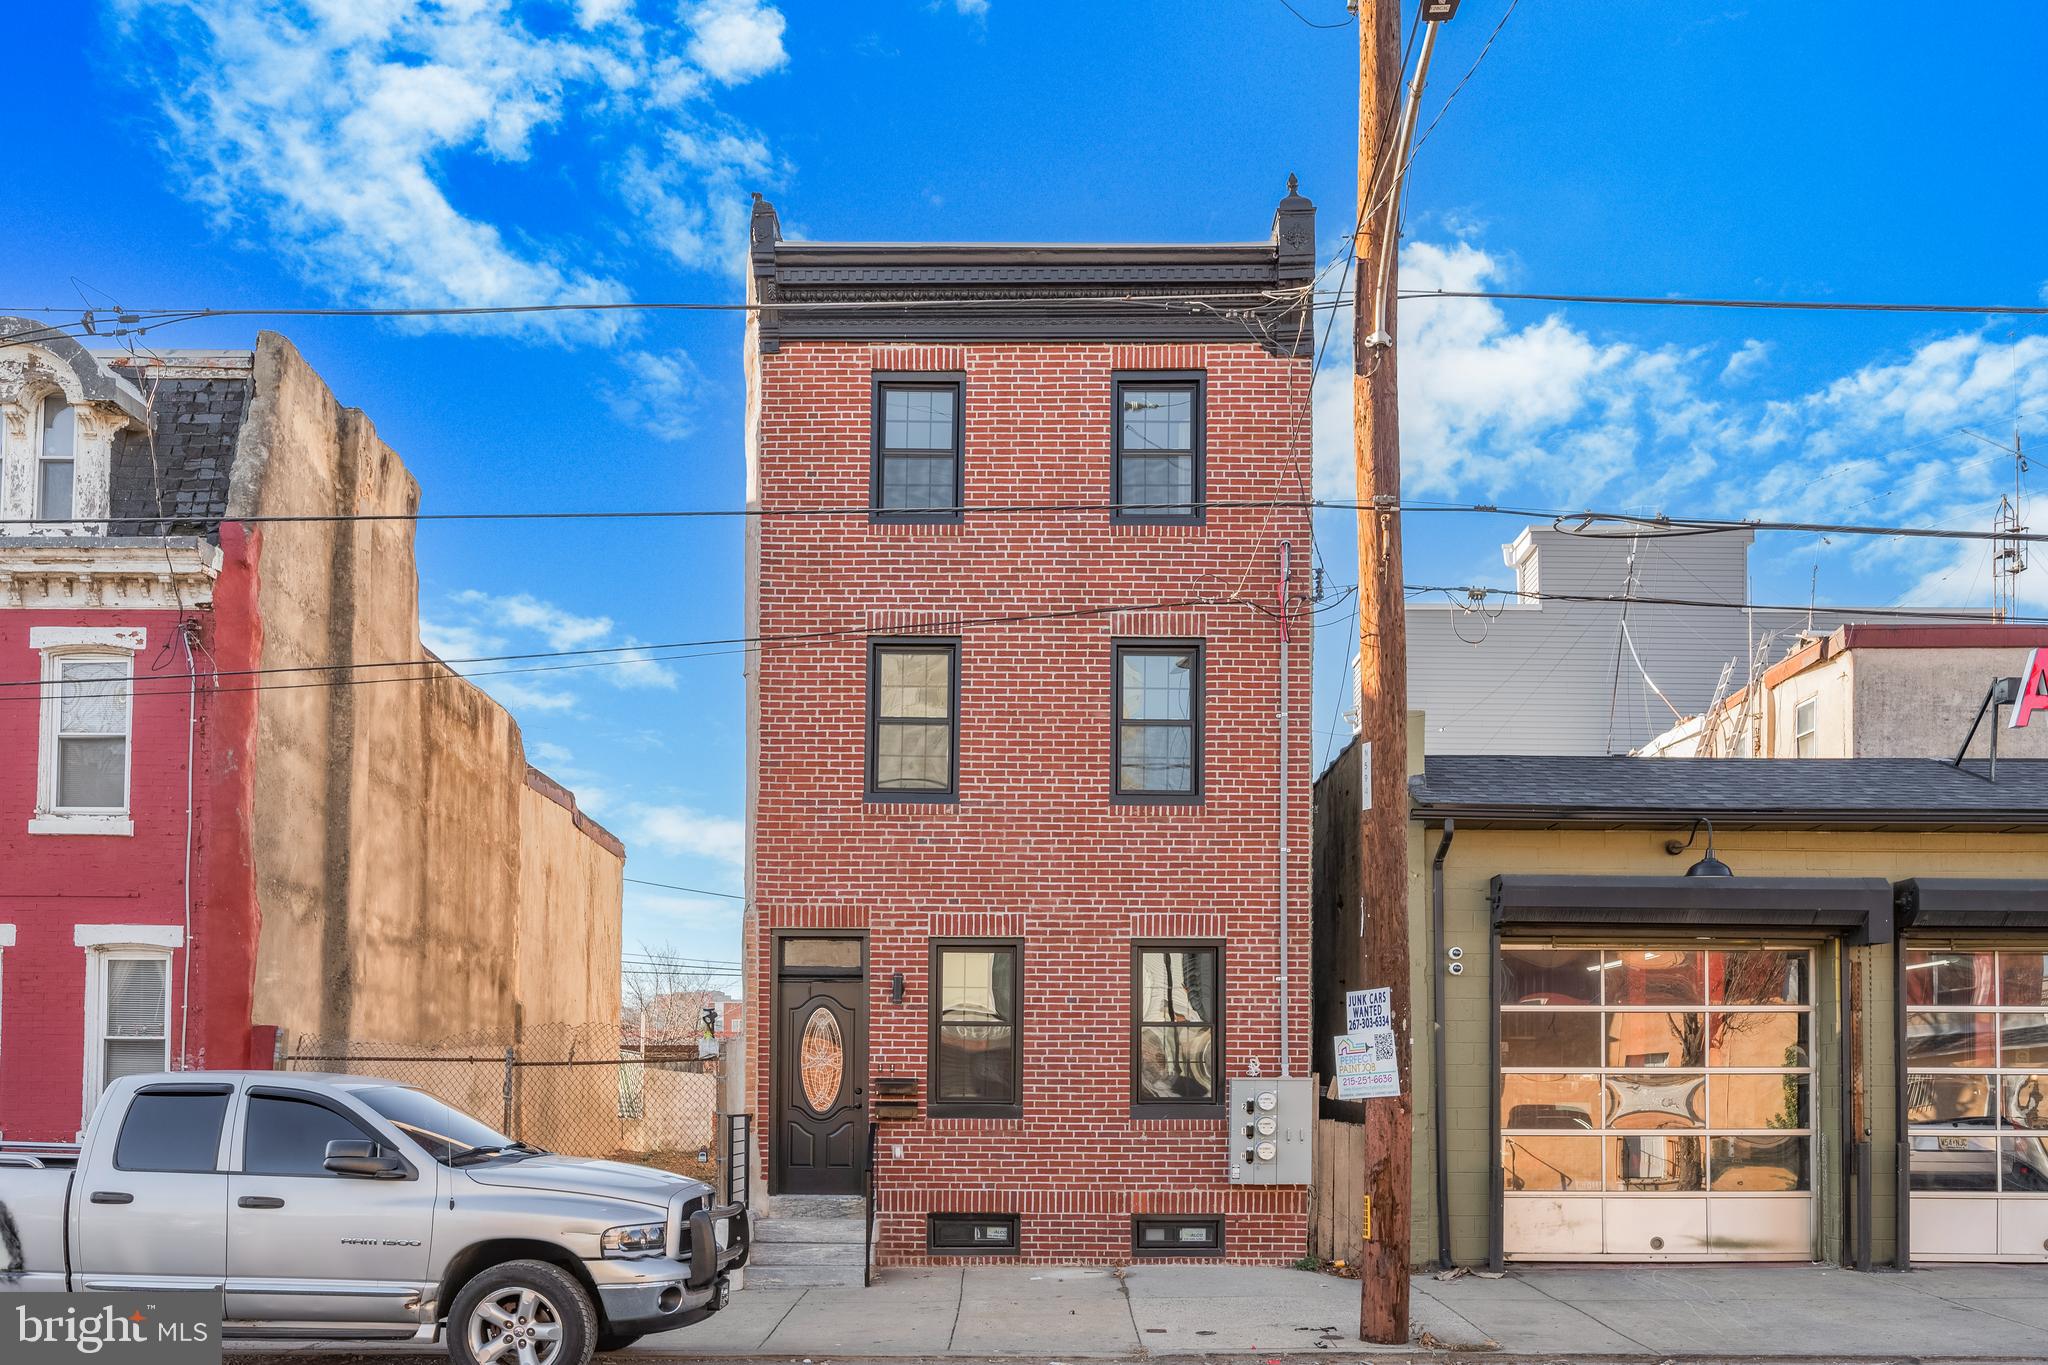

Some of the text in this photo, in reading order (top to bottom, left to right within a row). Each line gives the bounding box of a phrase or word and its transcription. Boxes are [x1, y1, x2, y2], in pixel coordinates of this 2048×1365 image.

[1348, 992, 1386, 1007] JUNK CARS
[1353, 1005, 1382, 1018] WANTED
[1349, 1016, 1389, 1030] 267-303-6334
[1340, 1054, 1373, 1065] PERFECT
[1339, 1062, 1376, 1073] PAINT JOB
[340, 1237, 422, 1247] RAM 1500
